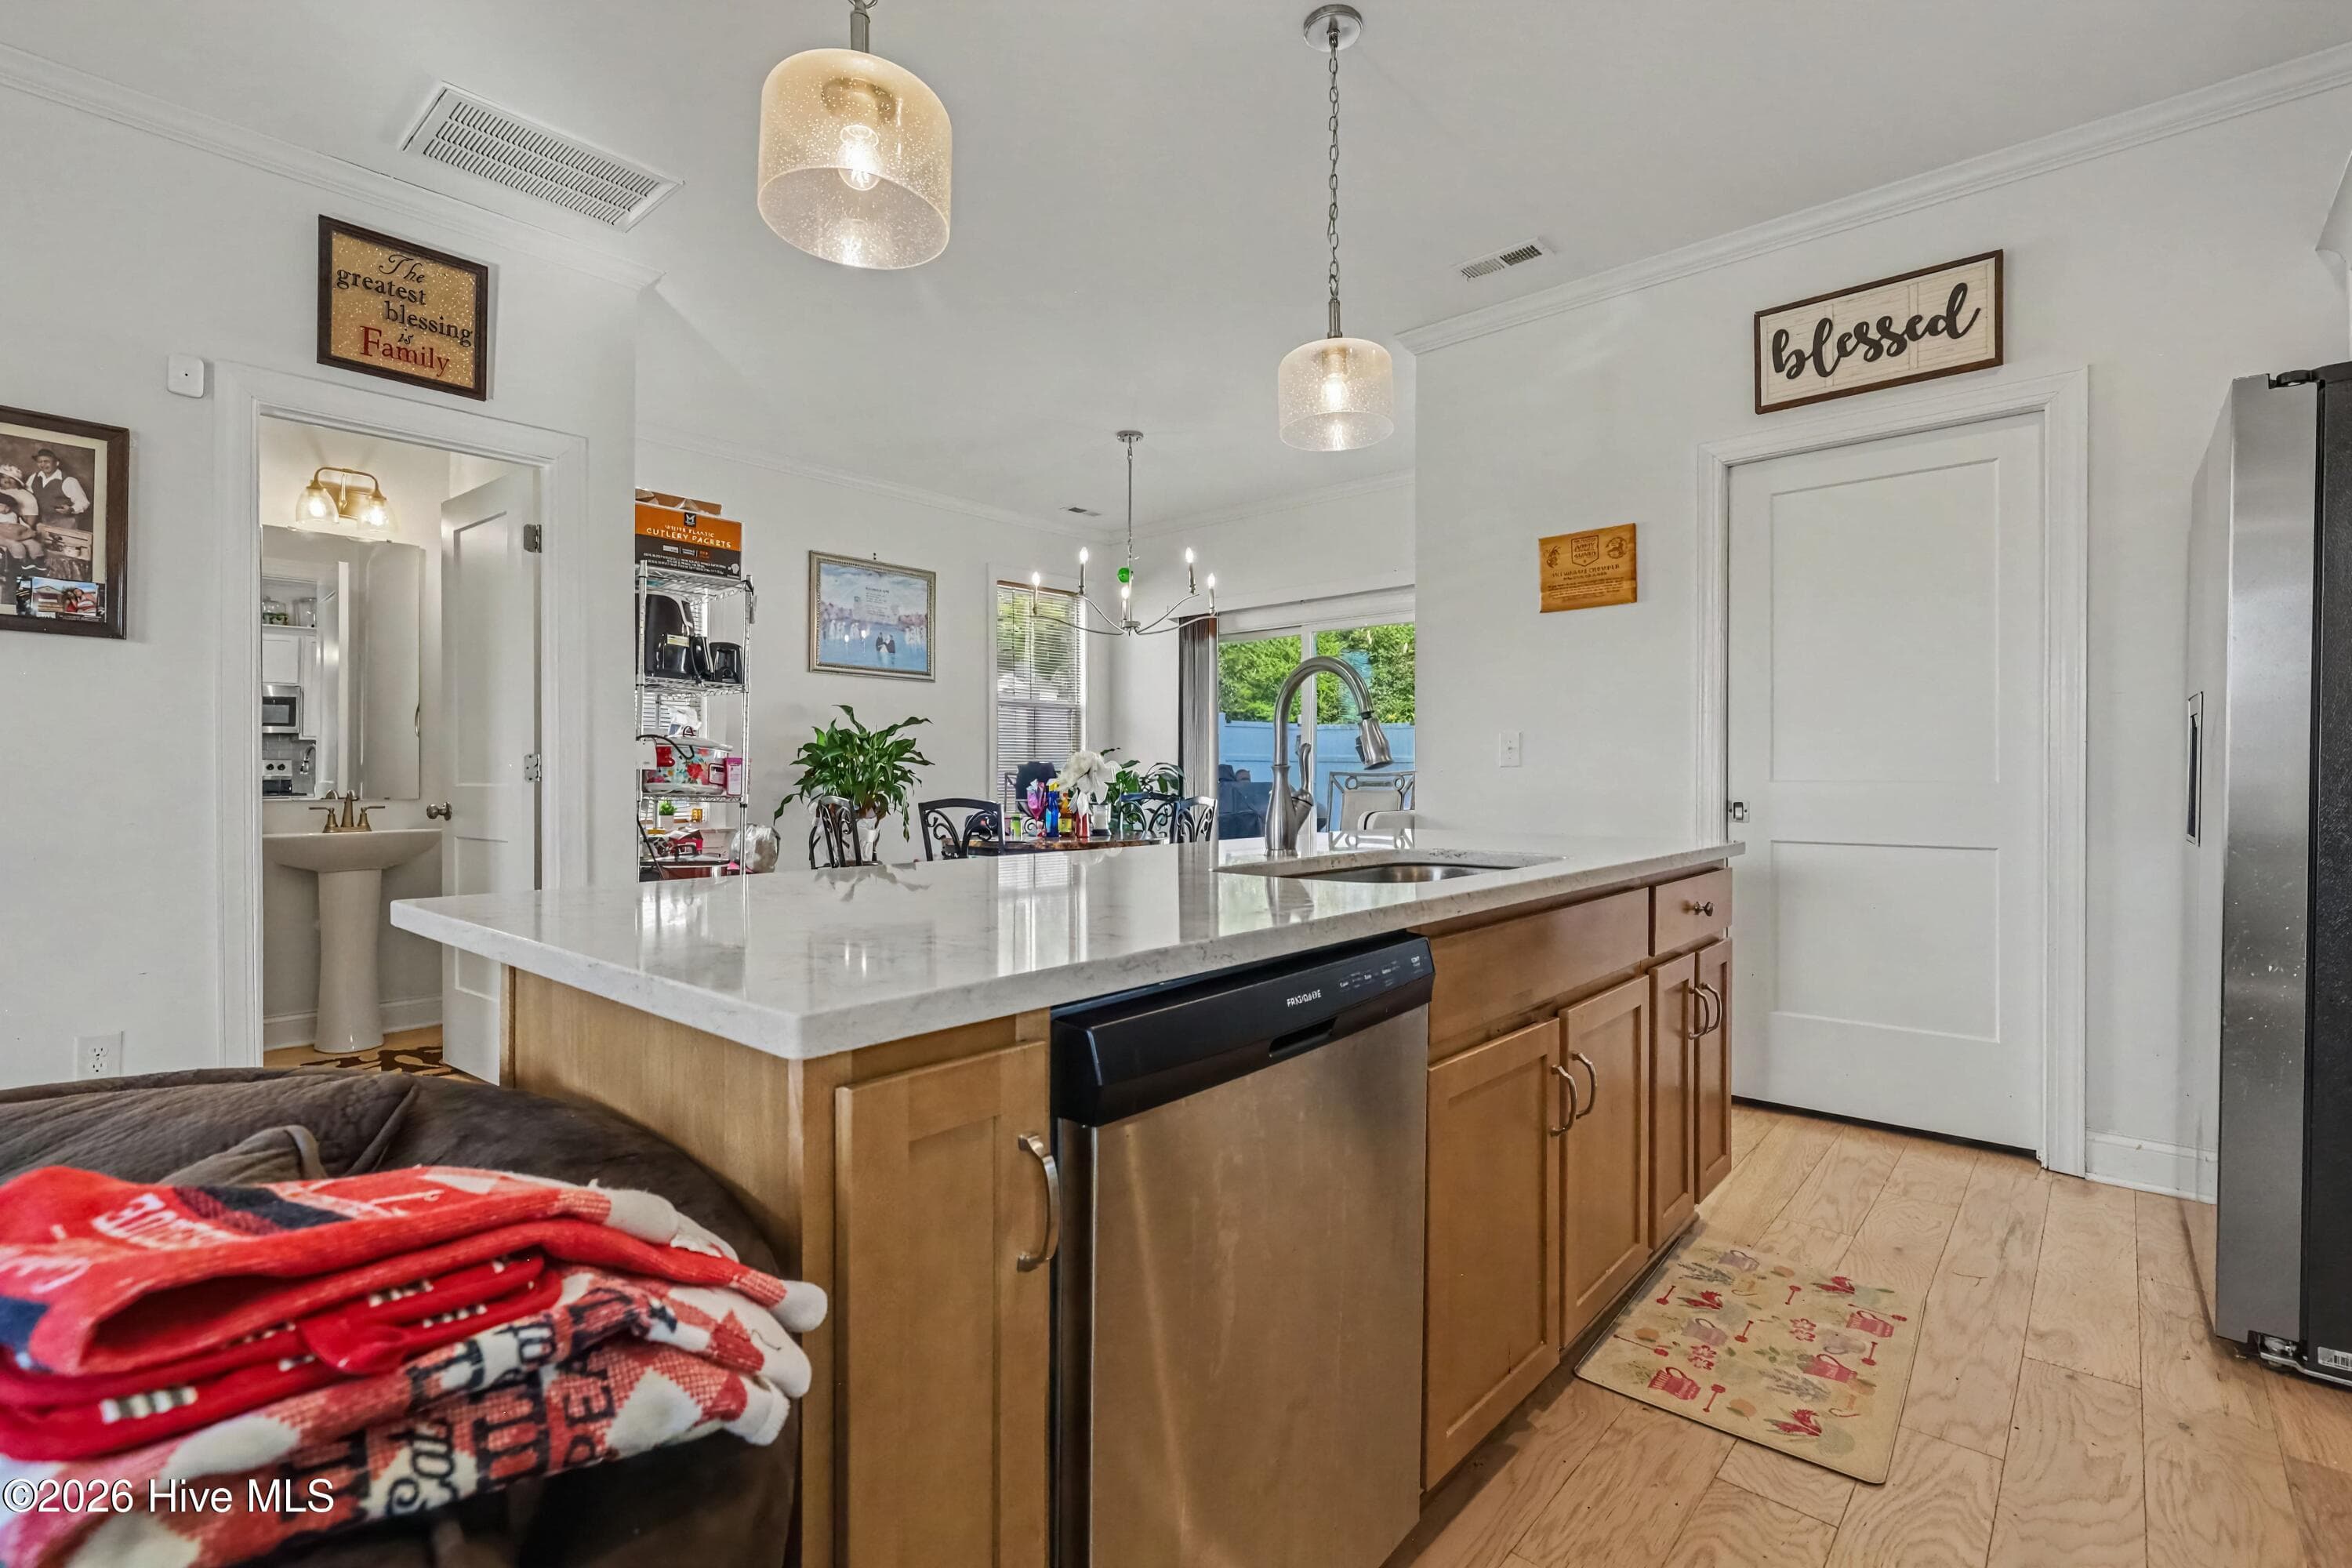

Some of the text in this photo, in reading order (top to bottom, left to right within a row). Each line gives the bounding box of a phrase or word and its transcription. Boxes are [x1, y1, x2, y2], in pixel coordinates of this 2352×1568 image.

[336, 269, 426, 305] greatest
[378, 254, 425, 284] The
[383, 300, 474, 348] blessing
[397, 328, 415, 345] is
[1772, 282, 1981, 379] blessed
[359, 325, 450, 377] Family
[646, 528, 688, 540] CUTLERY
